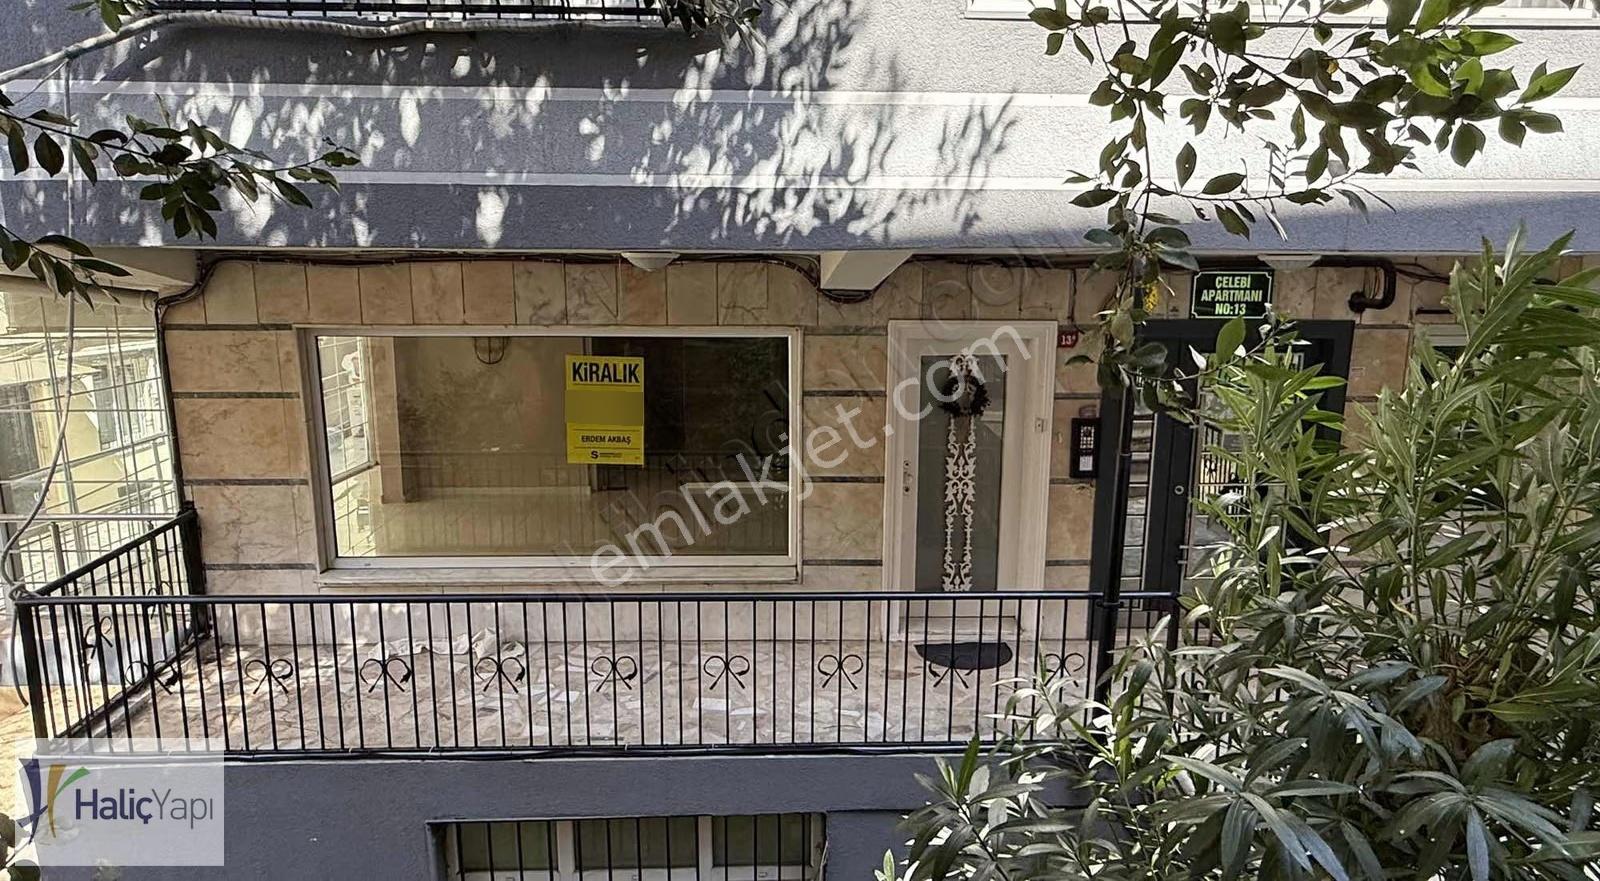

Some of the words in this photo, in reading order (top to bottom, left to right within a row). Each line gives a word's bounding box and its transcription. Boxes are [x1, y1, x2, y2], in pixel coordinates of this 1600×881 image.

[1215, 275, 1252, 289] ÇELEBİ
[1200, 289, 1263, 302] APARTMANI
[1214, 303, 1247, 315] NO:13
[581, 435, 606, 443] ERDEM
[607, 435, 632, 446] AKBAŞ
